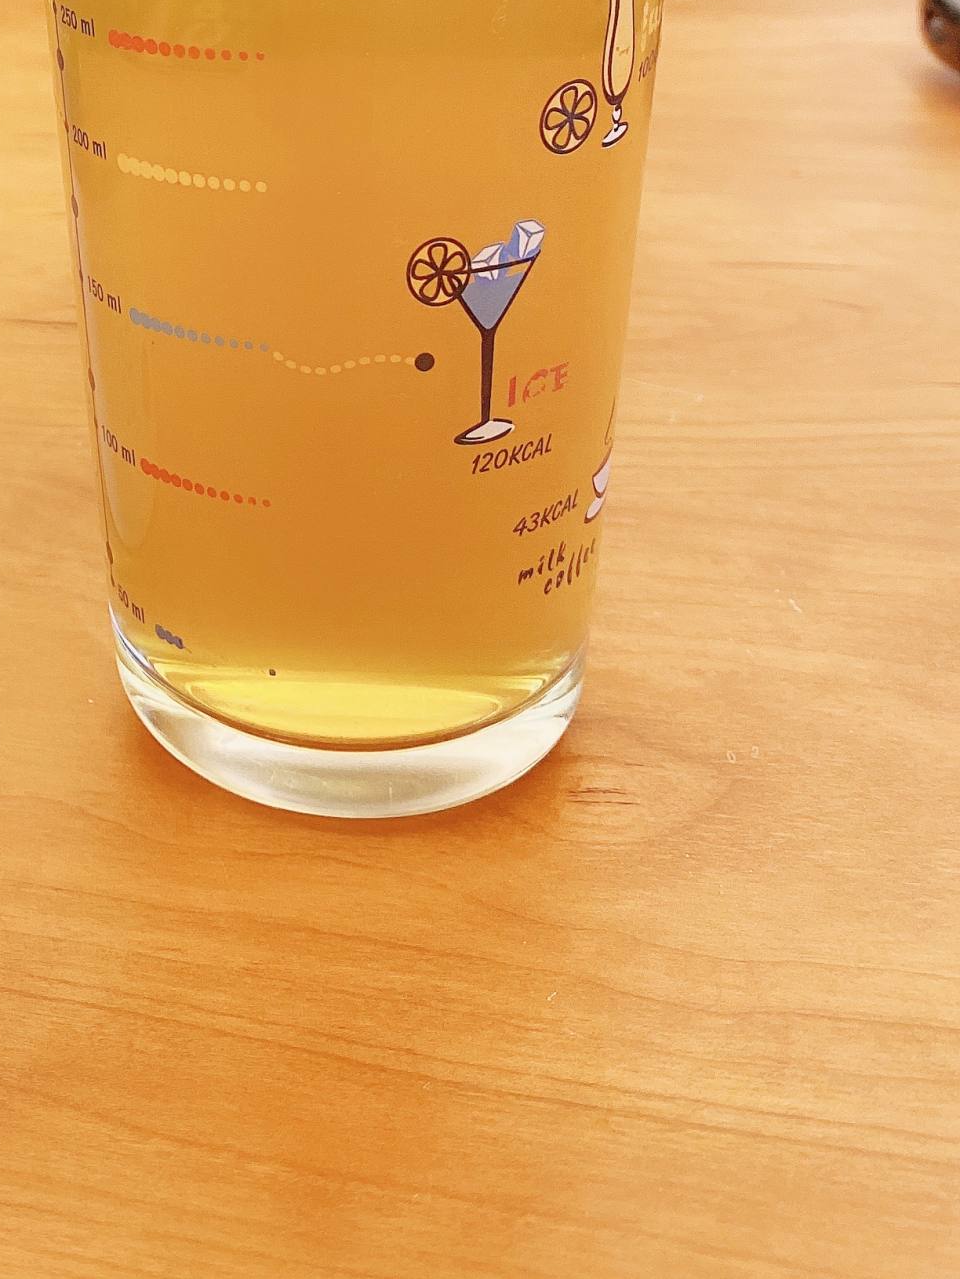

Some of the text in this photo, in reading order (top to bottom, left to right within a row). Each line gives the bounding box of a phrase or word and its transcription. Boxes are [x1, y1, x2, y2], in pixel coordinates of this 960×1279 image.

[60, 4, 96, 38] 250 ml
[71, 124, 107, 161] 200 ml
[87, 275, 122, 314] 150 ml
[101, 424, 136, 467] 100 ml
[471, 433, 553, 474] 120KCAL
[512, 488, 579, 536] 43KCAL
[117, 583, 145, 624] 50 ml
